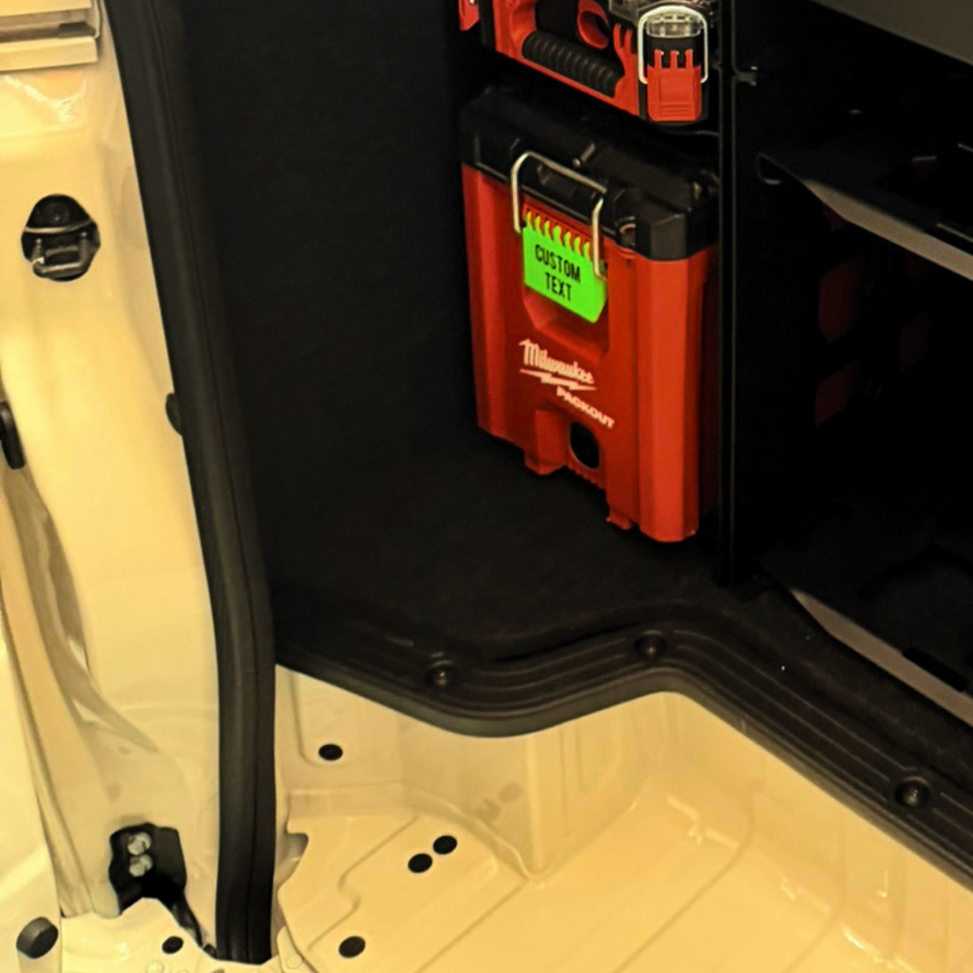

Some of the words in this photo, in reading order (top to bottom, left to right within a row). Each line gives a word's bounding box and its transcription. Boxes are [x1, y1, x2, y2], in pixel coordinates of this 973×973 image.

[535, 243, 581, 284] CUSTOM
[545, 272, 572, 301] TEXT
[518, 338, 595, 385] Milwaukee
[556, 385, 615, 429] PACKOUT
